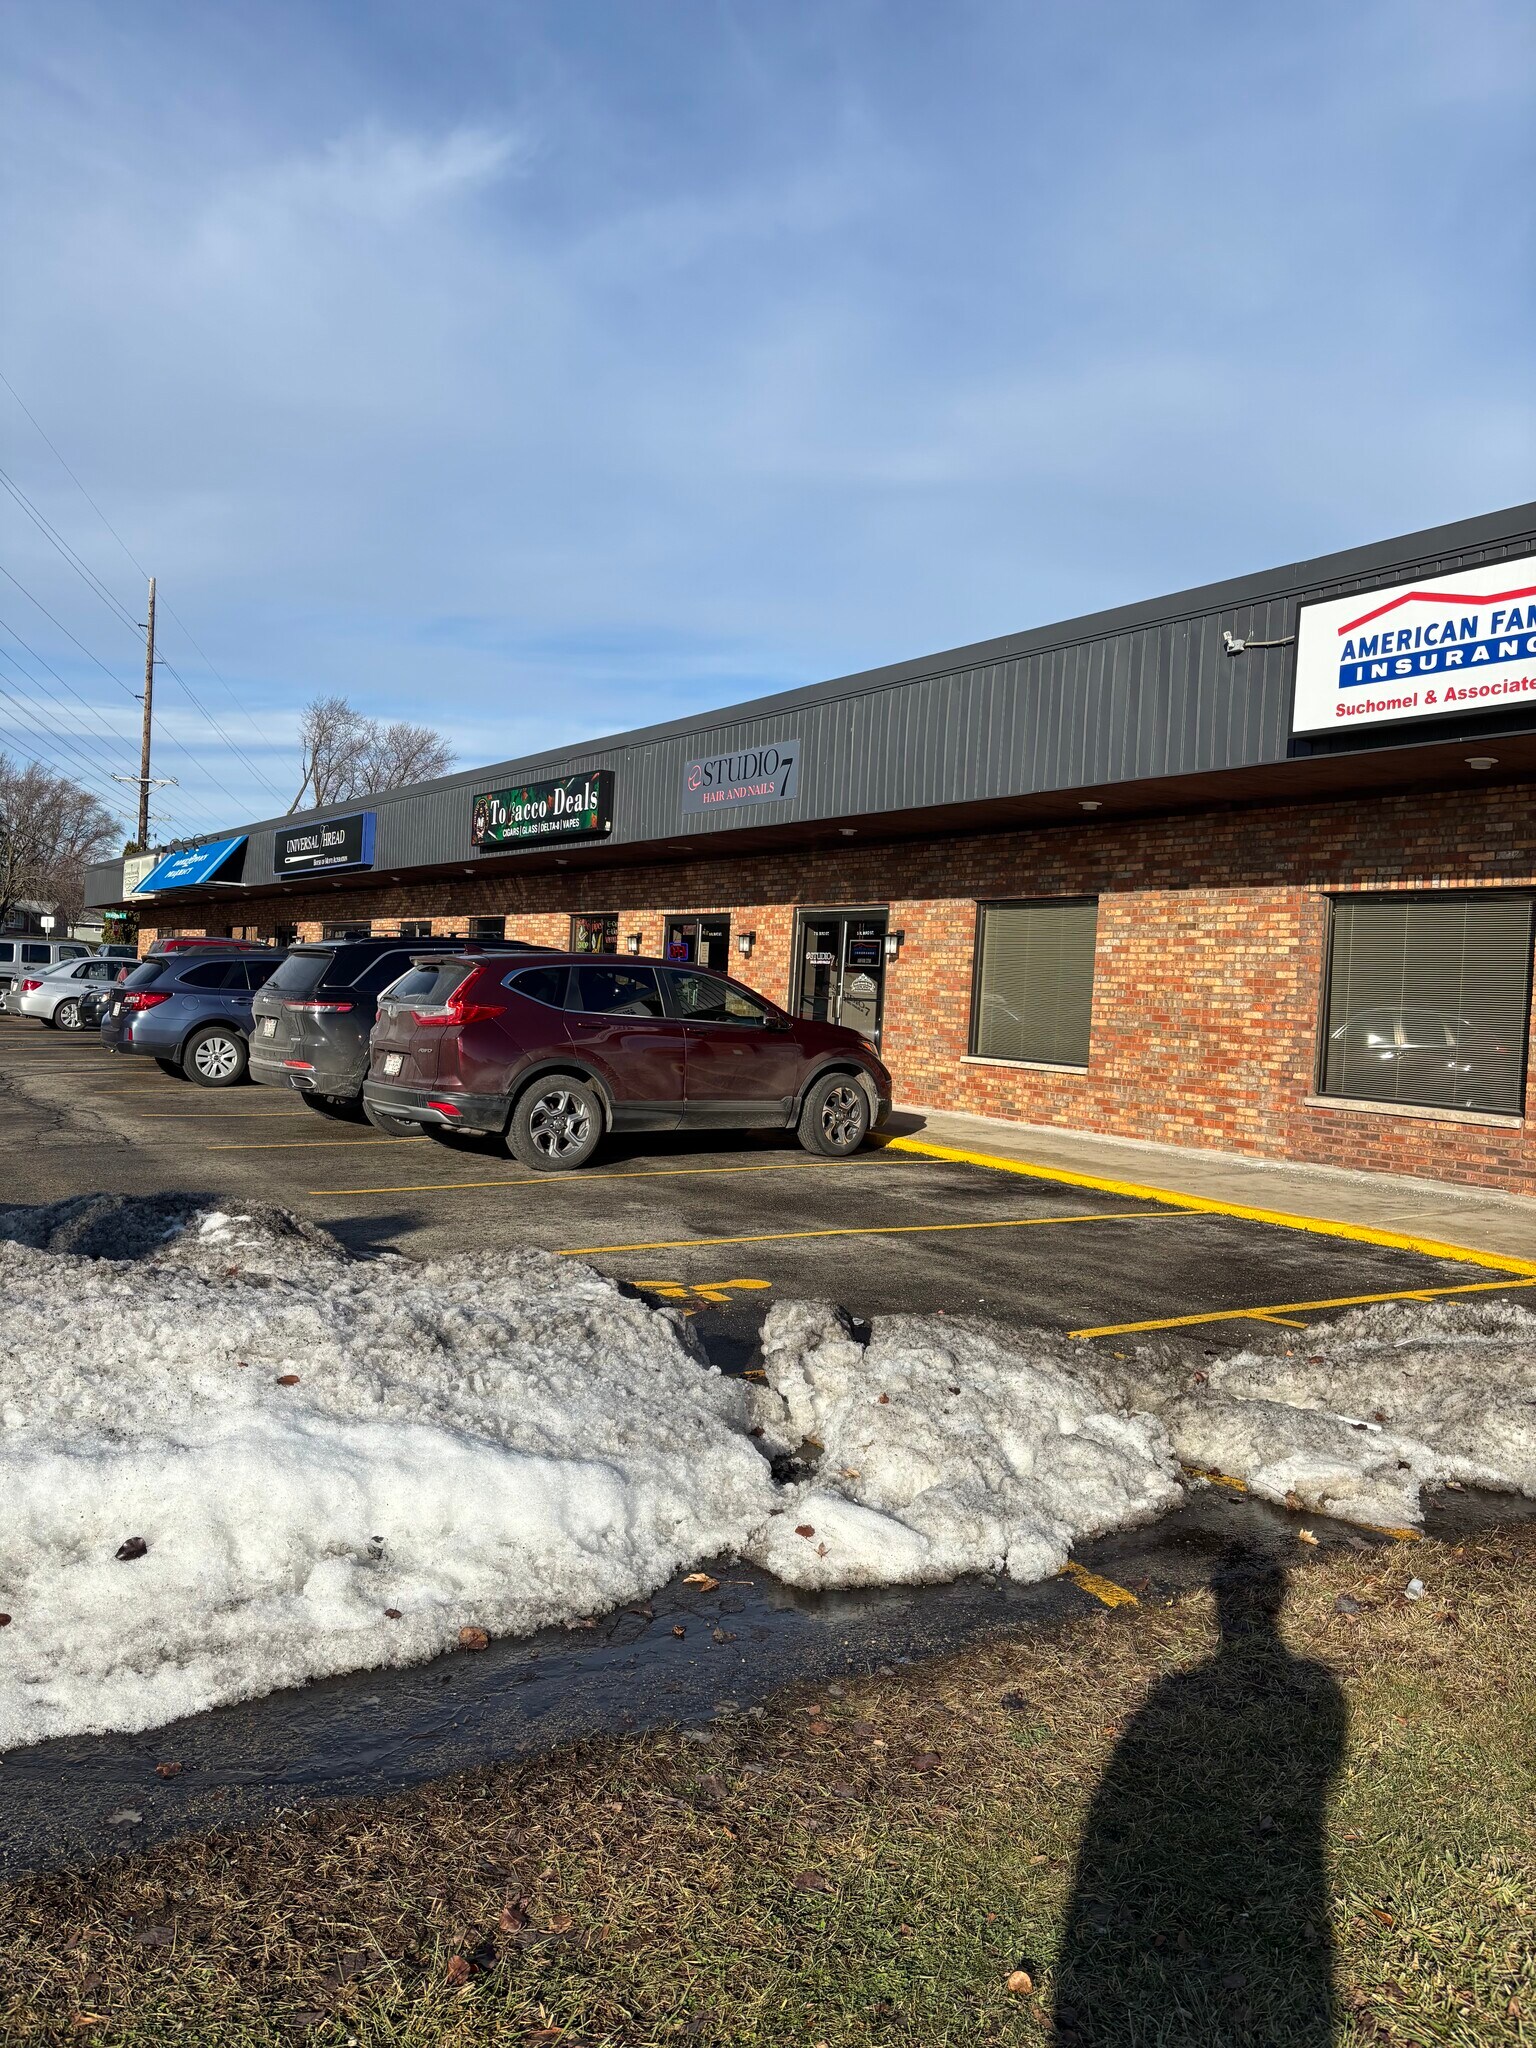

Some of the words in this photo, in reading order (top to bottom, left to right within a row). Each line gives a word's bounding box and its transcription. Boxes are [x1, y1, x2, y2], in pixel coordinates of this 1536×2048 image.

[1340, 615, 1479, 662] AMERICAN
[1335, 692, 1418, 717] Suchomel
[1424, 689, 1438, 705] &
[703, 749, 779, 787] STUDIO
[780, 757, 794, 797] 7
[553, 782, 598, 815] Deals
[703, 791, 725, 804] HAIR
[726, 786, 747, 800] AND
[748, 781, 775, 797] NAILS
[502, 826, 520, 838] CIGARS
[522, 824, 538, 835] GLASS
[562, 817, 580, 829] VAPES
[286, 834, 320, 853] UNIVERSAL
